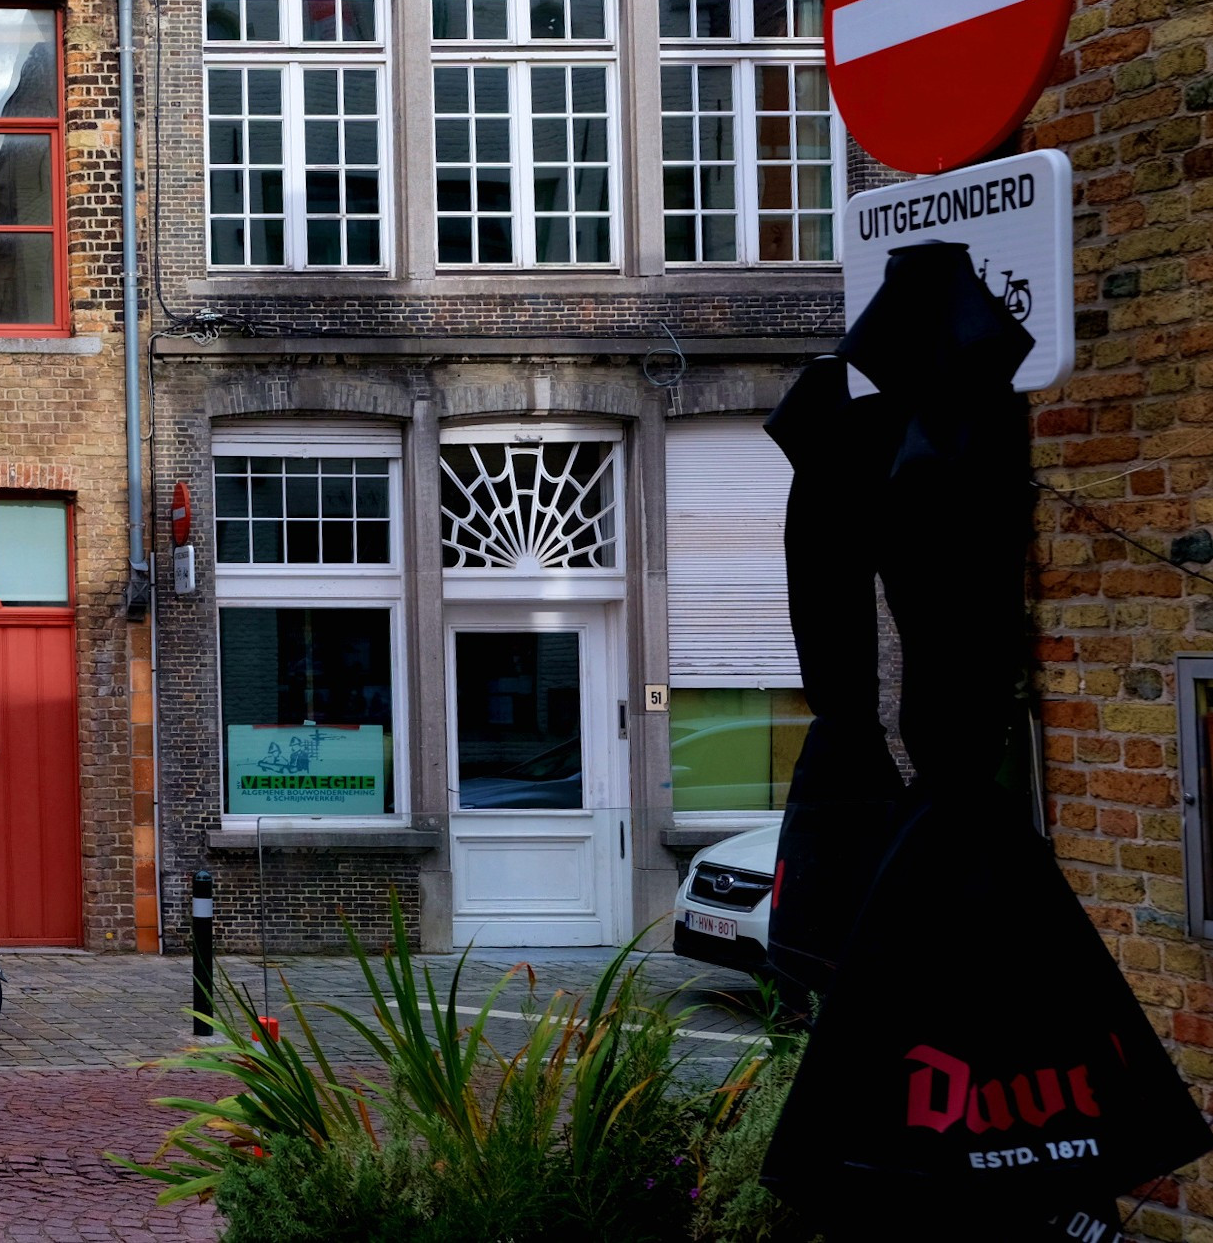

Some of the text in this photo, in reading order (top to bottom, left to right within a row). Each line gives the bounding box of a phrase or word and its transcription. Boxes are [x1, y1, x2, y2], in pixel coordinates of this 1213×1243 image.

[859, 173, 1035, 241] UITGEZONDERD
[651, 691, 662, 705] 51
[241, 775, 375, 789] VERHAEGHE
[273, 795, 345, 803] SCHRIJNWERKERIJ
[969, 1138, 1099, 1169] ESTD. 1871
